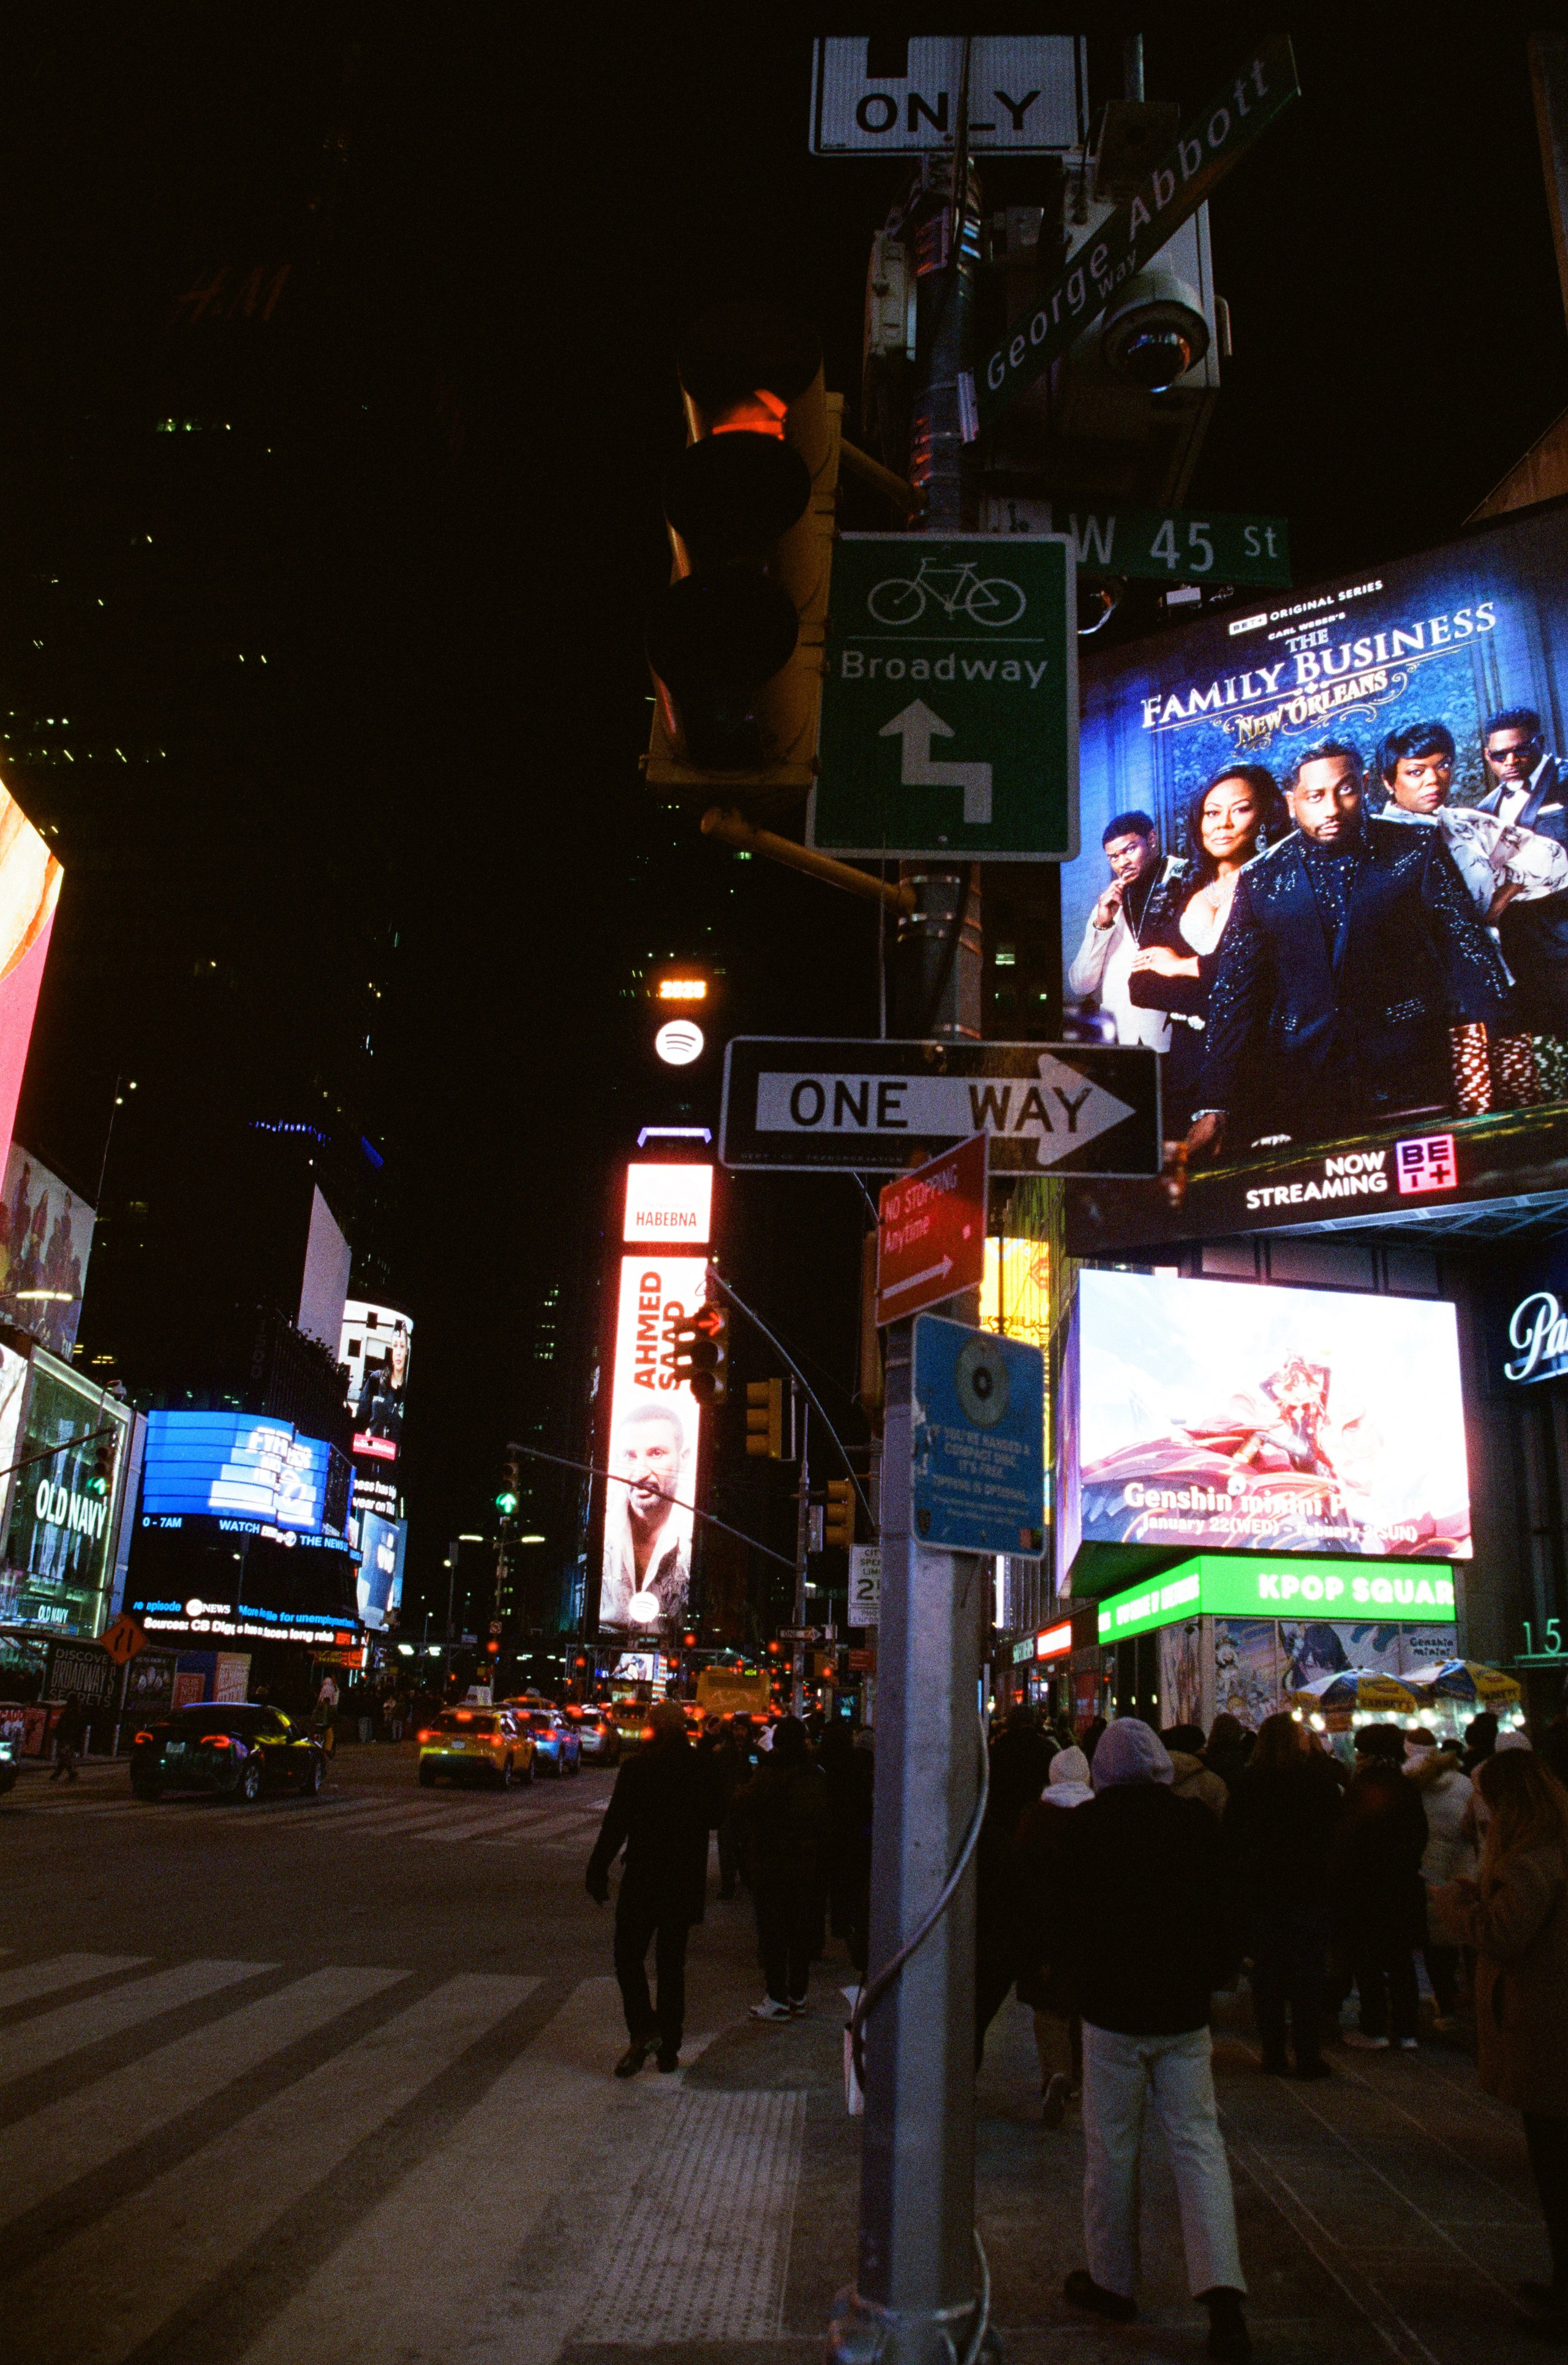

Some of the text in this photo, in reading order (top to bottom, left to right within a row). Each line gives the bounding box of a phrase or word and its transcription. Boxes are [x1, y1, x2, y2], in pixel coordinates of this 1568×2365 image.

[987, 58, 1268, 391] George Abbott
[1098, 250, 1137, 297] Way
[1069, 513, 1277, 571] W 45 St
[1270, 595, 1333, 621] ORIGINAL
[1338, 580, 1383, 603] SERIES
[1268, 628, 1296, 641] CARL
[1286, 630, 1328, 653] THE
[841, 650, 1047, 689] Broadway
[1141, 602, 1496, 728] FAMILY BUSINESS
[1235, 670, 1388, 747] NEW ORLEANS
[660, 981, 706, 998] 2025
[790, 1079, 1092, 1133] ONE WAY
[1325, 1150, 1385, 1177] NOW
[885, 1164, 958, 1221] NO STOPPING
[1246, 1172, 1387, 1209] STREAMING
[636, 1212, 696, 1227] HABEBNA
[884, 1215, 929, 1254] Anytime
[633, 1271, 662, 1390] AHMED
[36, 1479, 108, 1540] OLD NAVY
[1125, 1482, 1232, 1512] Genshin
[1242, 1491, 1321, 1517] minini
[160, 1518, 182, 1528] 7AM
[220, 1520, 260, 1533] WATCH
[300, 1535, 322, 1547] THE
[324, 1537, 344, 1550] NEWS
[1143, 1514, 1205, 1536] January
[1211, 1517, 1280, 1537] 22(WED)
[1297, 1522, 1360, 1543] Febuary
[1363, 1525, 1418, 1544] 2(SUN)
[1259, 1574, 1454, 1605] KPOP SQUAR
[38, 1605, 69, 1624] OLD NAVY
[146, 1600, 182, 1612] episode
[202, 1604, 232, 1615] NEWS
[280, 1612, 295, 1622] for
[143, 1616, 189, 1631] Sources:
[191, 1619, 210, 1632] CB
[290, 1628, 314, 1643] long
[1410, 1637, 1453, 1647] Genshin
[1523, 1618, 1562, 1654] 15
[55, 1649, 116, 1664] DISCOVE
[1413, 1647, 1450, 1656] minini
